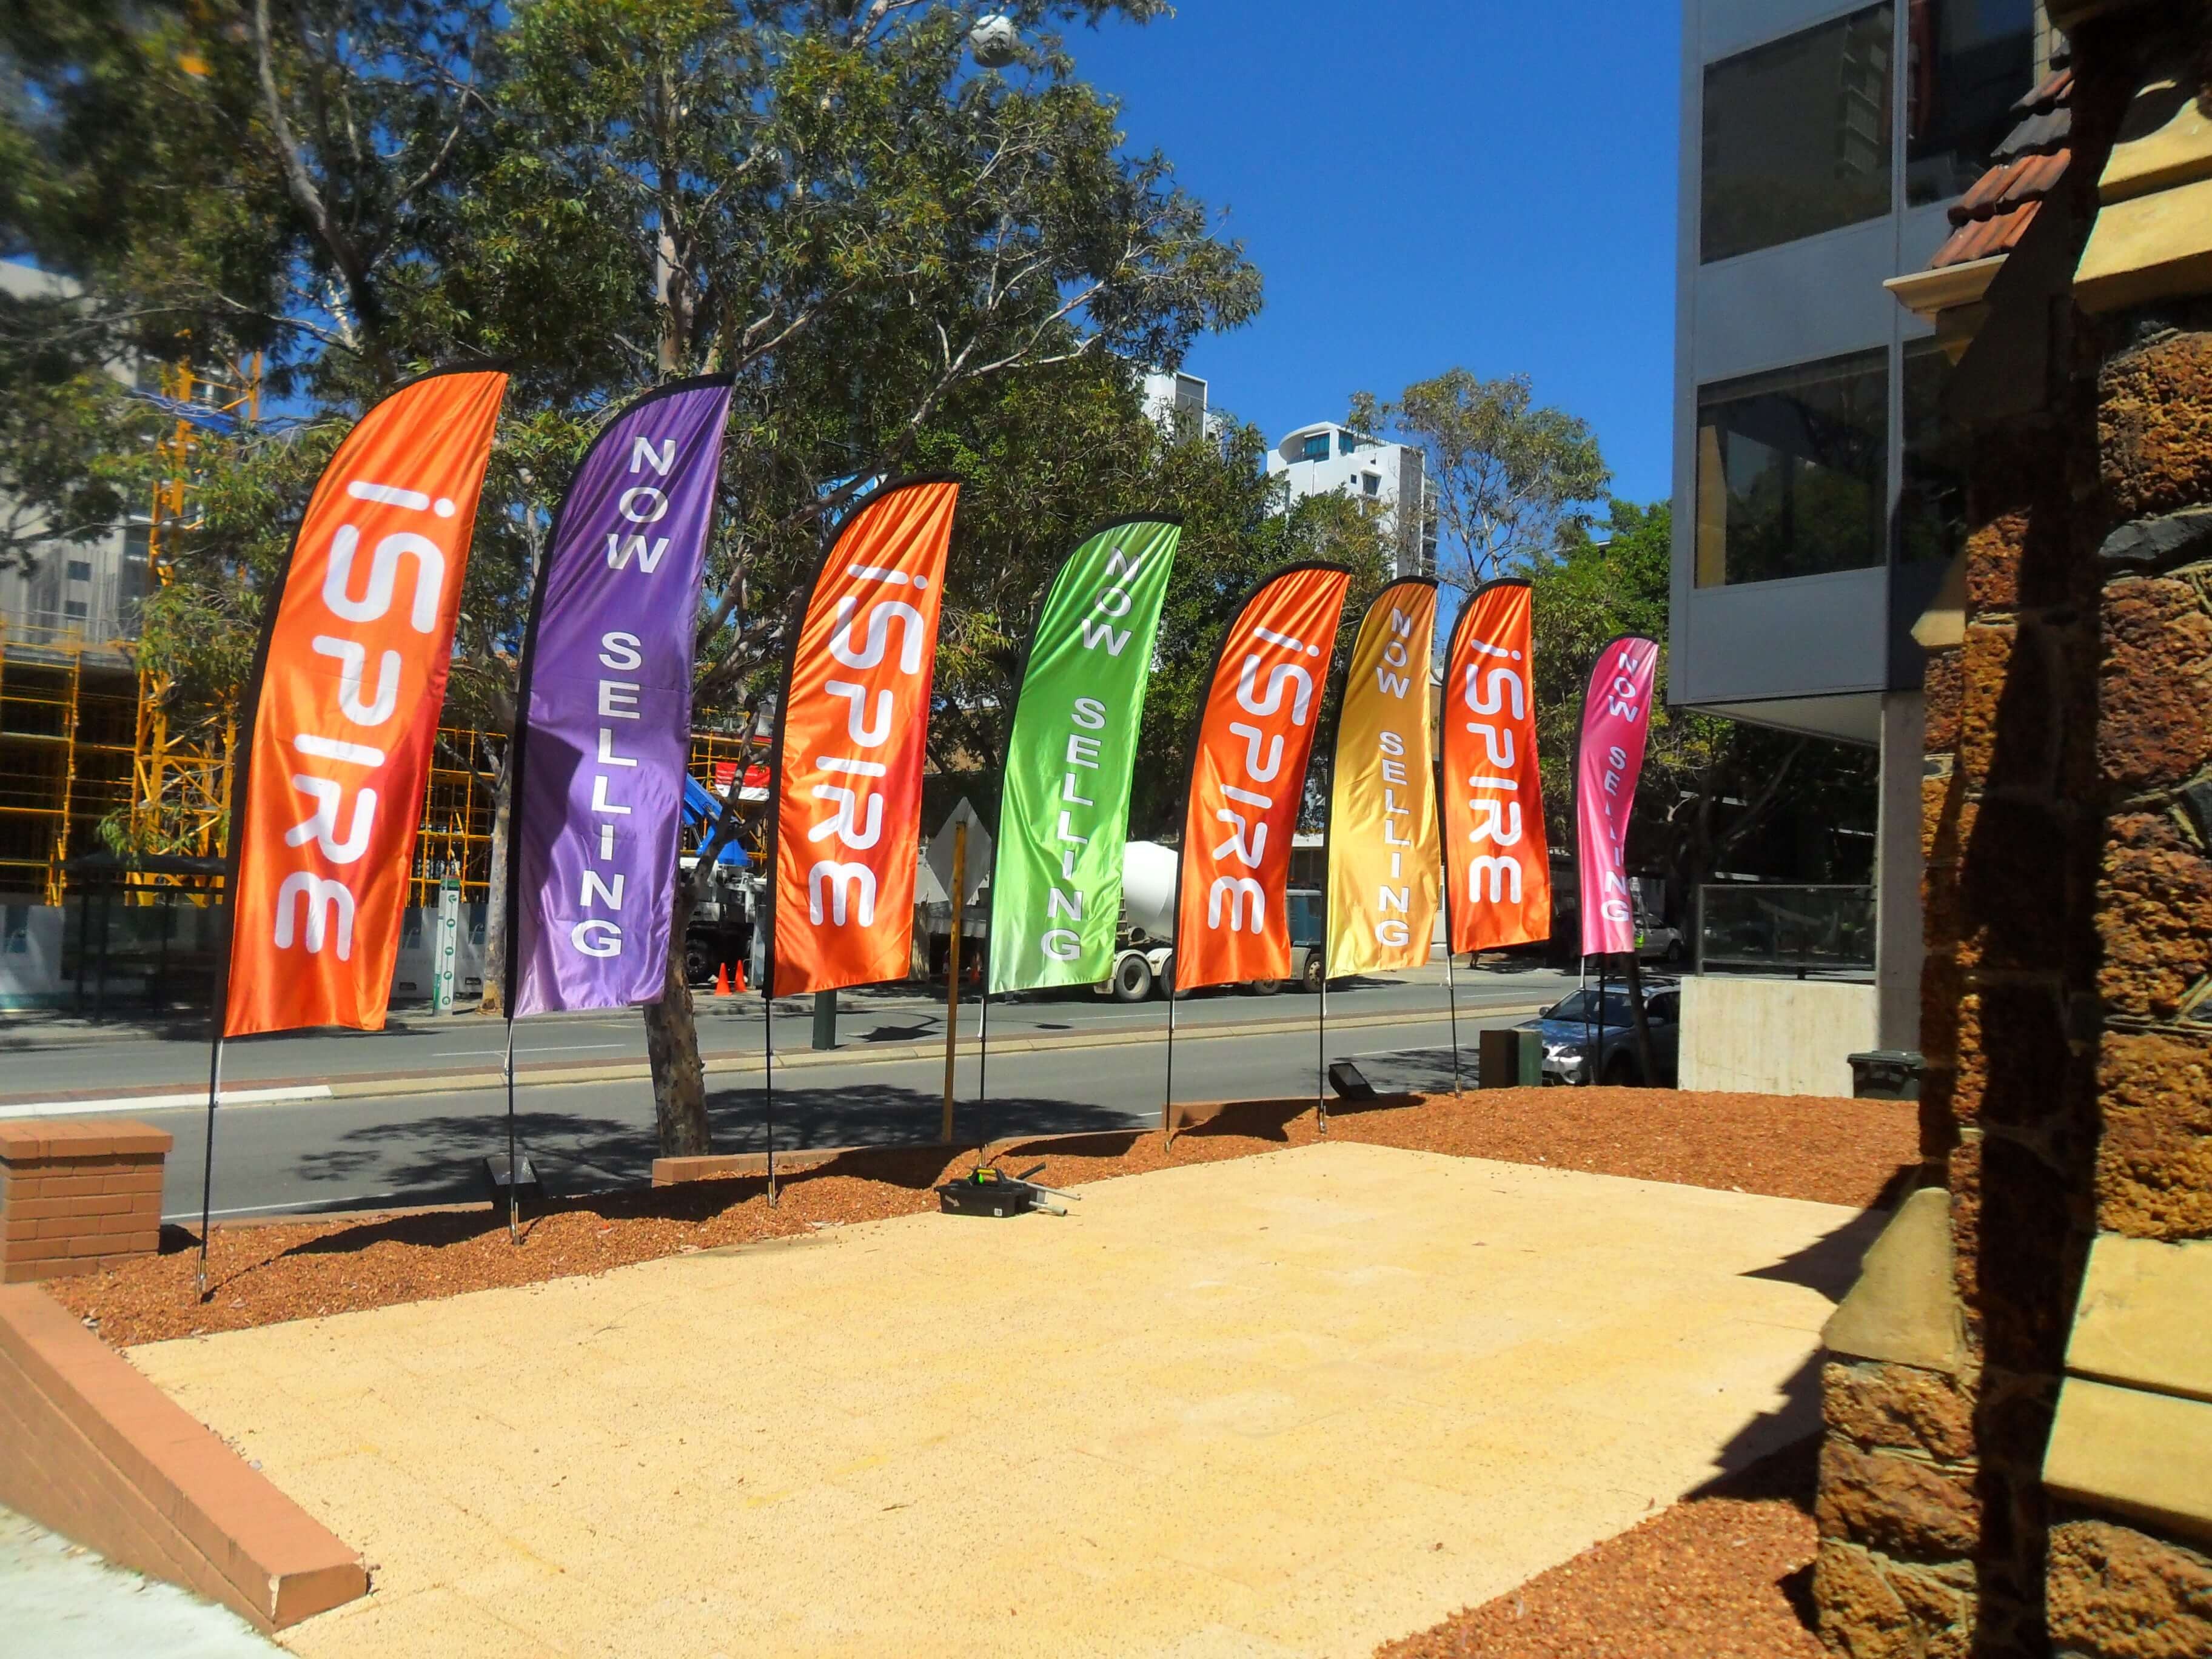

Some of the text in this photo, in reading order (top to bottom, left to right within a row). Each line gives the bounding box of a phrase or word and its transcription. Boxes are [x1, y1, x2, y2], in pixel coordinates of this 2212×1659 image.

[571, 437, 676, 957] NOW SELLING
[1041, 546, 1141, 961] NOW SELLING
[1375, 608, 1412, 947] NOW SELLING
[1608, 652, 1638, 723] NOW
